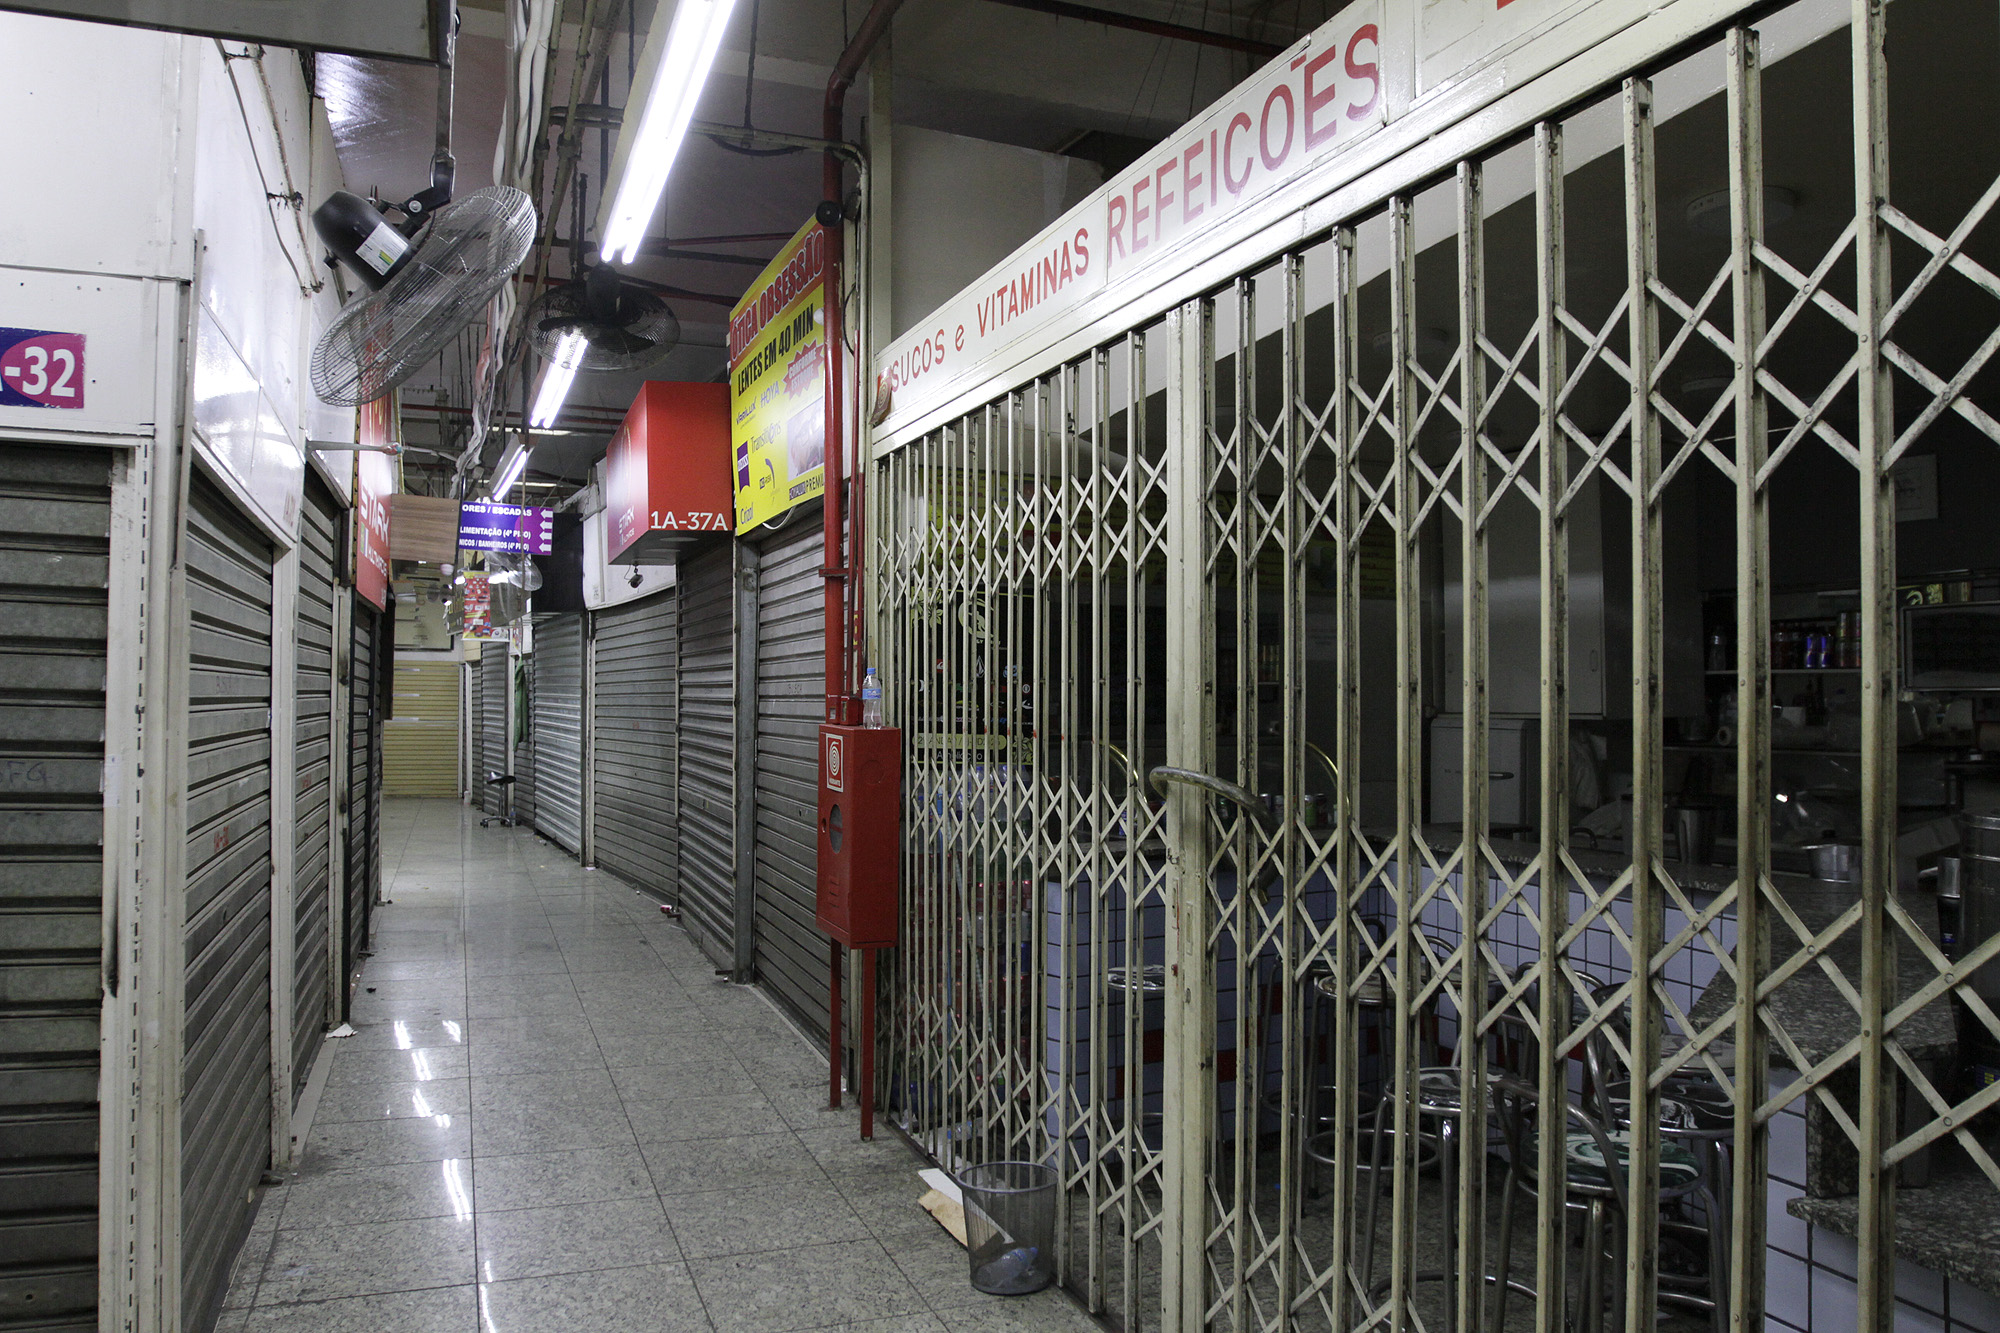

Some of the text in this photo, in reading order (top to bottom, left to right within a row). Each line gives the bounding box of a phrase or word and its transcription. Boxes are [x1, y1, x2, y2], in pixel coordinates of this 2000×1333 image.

[890, 227, 1090, 393] SUCOS e VITAMINAS
[0, 346, 75, 397] -32
[738, 303, 814, 397] LENTES EM 40 MIN
[760, 381, 780, 409] HOYA
[360, 475, 391, 547] STARK
[650, 510, 729, 532] 1A-37A
